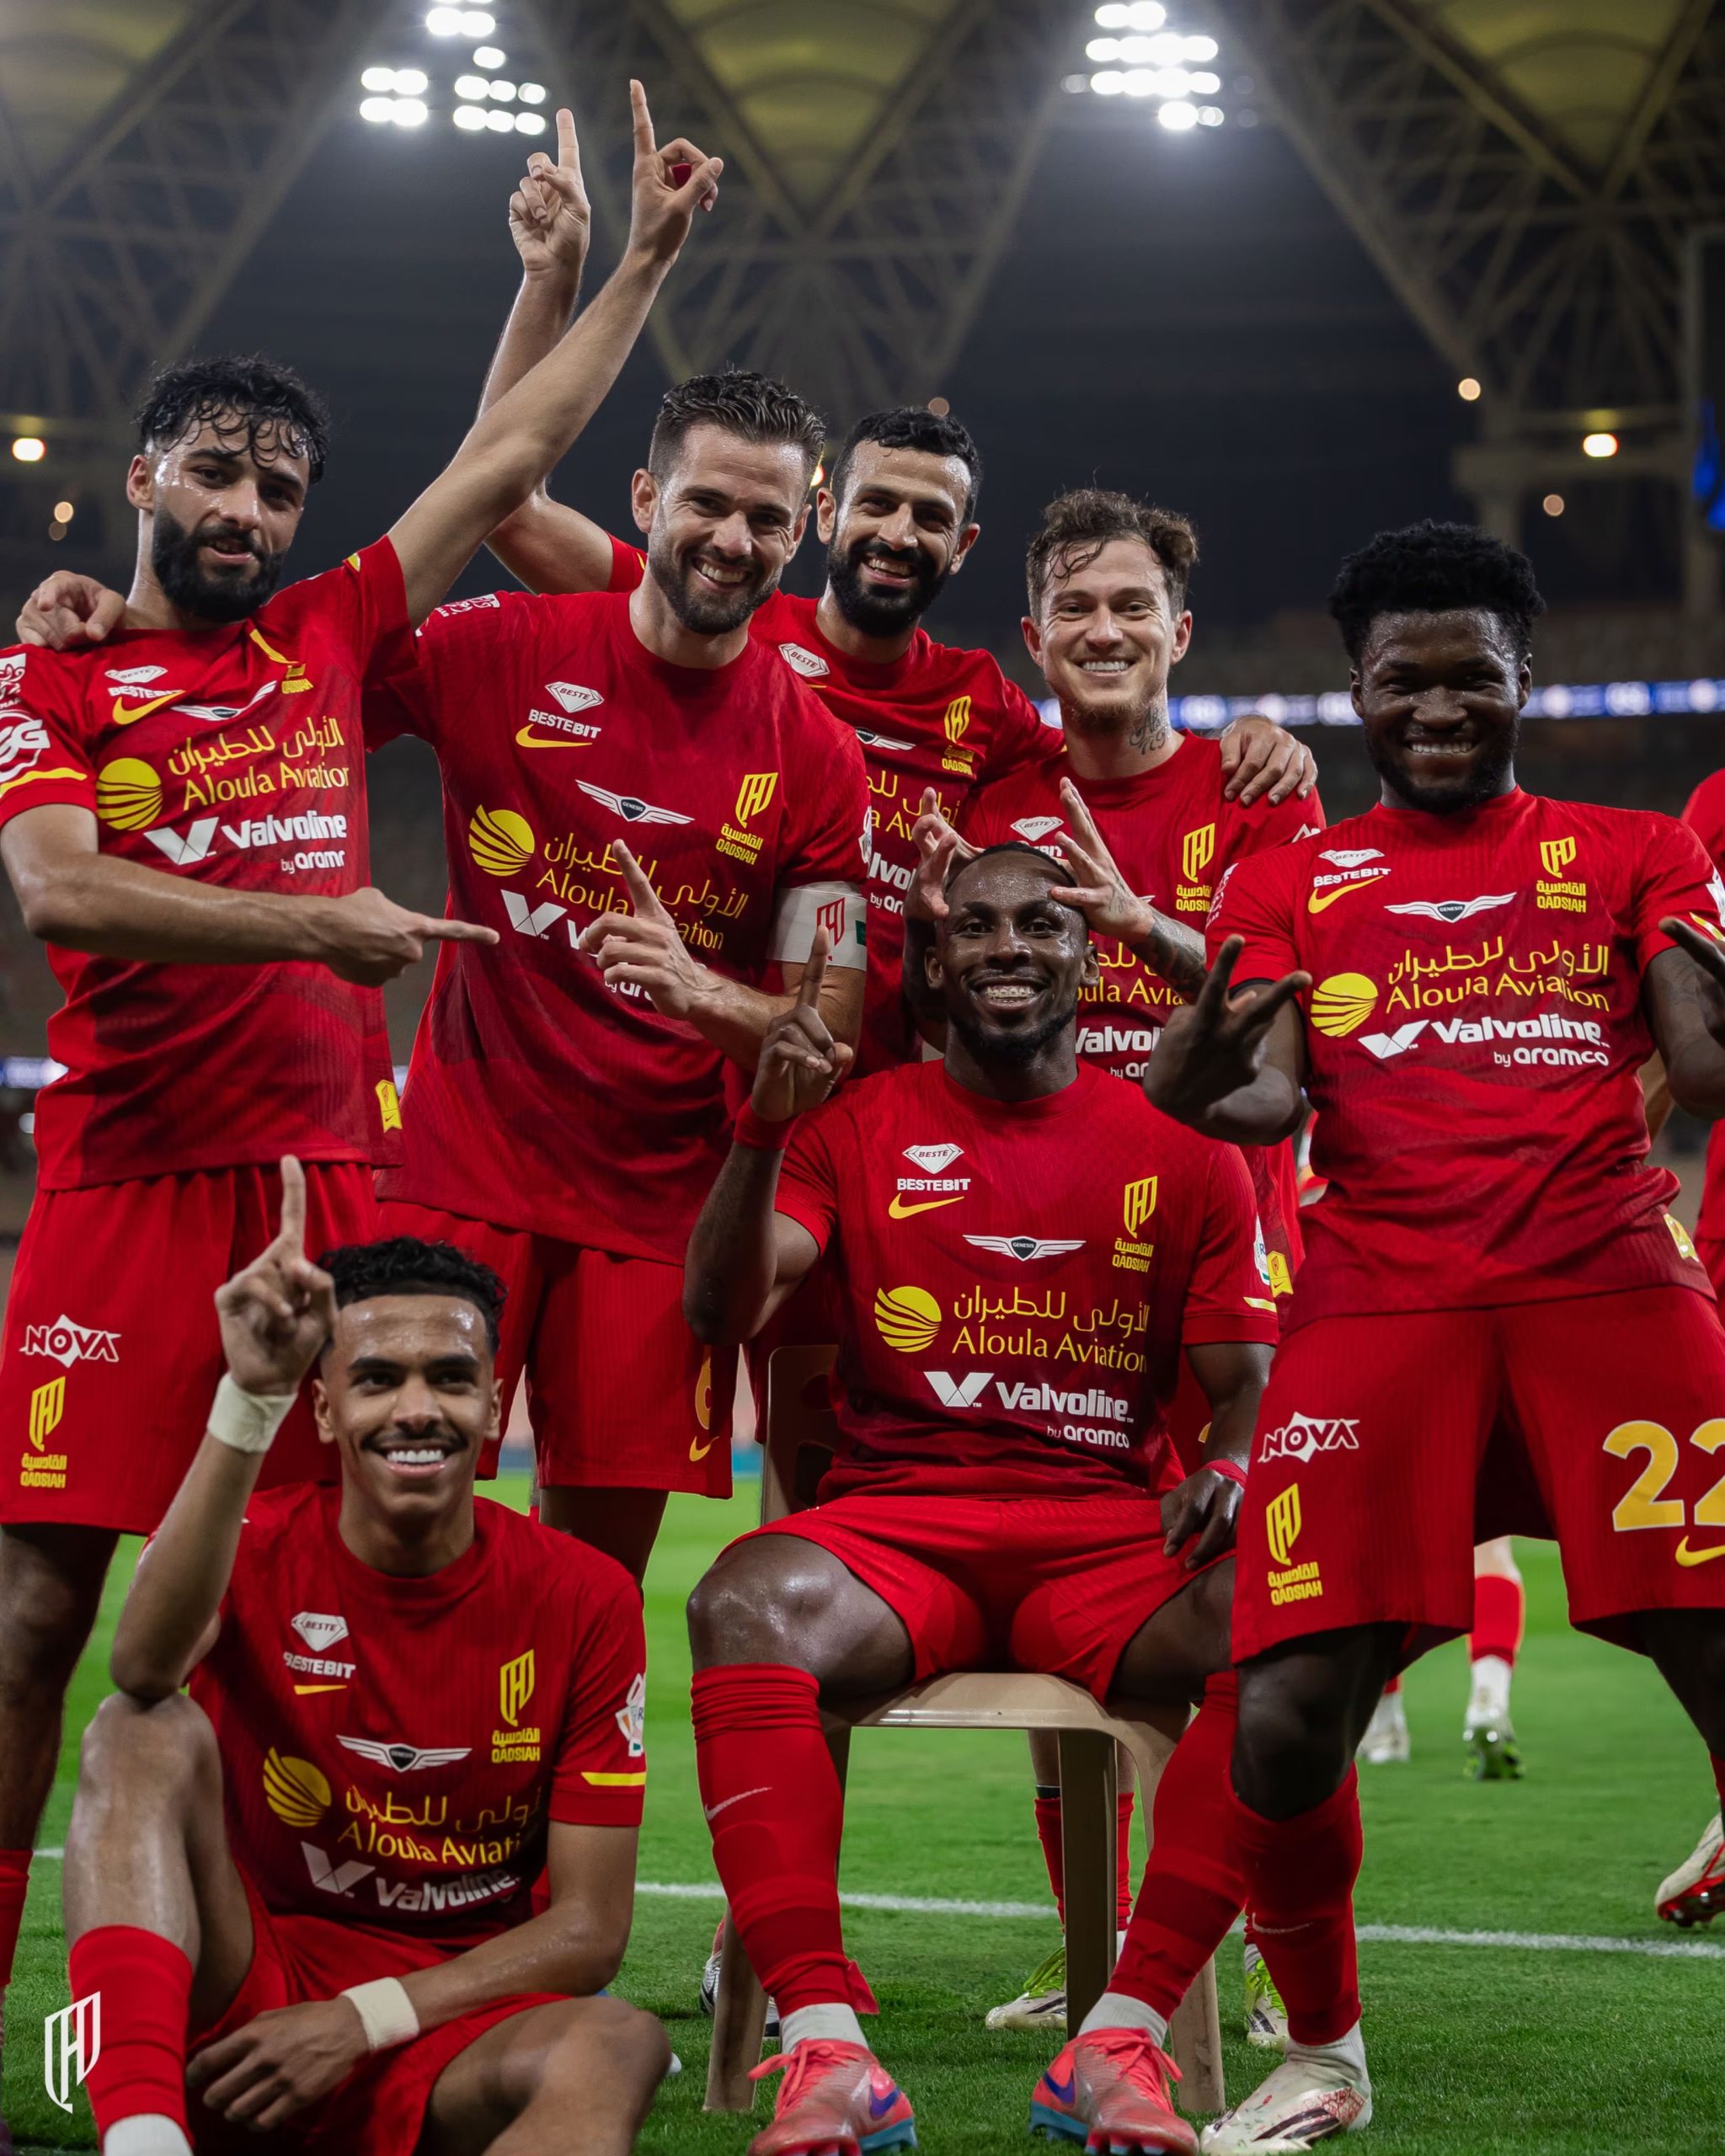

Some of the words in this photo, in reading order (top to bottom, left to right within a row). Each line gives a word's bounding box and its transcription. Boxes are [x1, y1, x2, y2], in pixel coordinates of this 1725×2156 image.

[789, 651, 819, 670] BESTE
[108, 685, 179, 699] BESTEB
[559, 687, 591, 701] BESTE
[528, 708, 602, 739] BESTEBIT
[168, 725, 276, 776] للطيران
[942, 758, 974, 776] QADS
[183, 766, 277, 811] Aloula
[221, 810, 348, 850] Valvoline
[720, 823, 764, 851] القادسية
[280, 857, 296, 875] by
[294, 850, 345, 870] aram
[543, 832, 658, 881] لطيران
[715, 839, 758, 866] QADSIAH
[1313, 867, 1391, 888] BESTEBIT
[1535, 879, 1587, 897] القادسية
[535, 867, 629, 915] Aloula
[674, 912, 724, 951] ation
[870, 893, 884, 909] by
[1438, 905, 1465, 913] GENESIS
[1535, 896, 1587, 913] QADSIAH
[1388, 936, 1504, 985] للطيران
[1509, 940, 1610, 977] الأولى
[1076, 976, 1121, 1003] ula
[1126, 978, 1184, 1006] Avia
[1386, 975, 1489, 1014] Aloula
[1075, 1026, 1165, 1054] Valvol
[1430, 1013, 1602, 1045] Valvoline
[1493, 1051, 1512, 1067] by
[1513, 1047, 1610, 1067] aramco
[918, 1149, 949, 1159] BESTE
[897, 1177, 971, 1192] BESTEBIT
[1114, 1237, 1154, 1258] القادسية
[1111, 1253, 1151, 1273] QADSIAH
[953, 1285, 1066, 1323] للطيران
[23, 1322, 120, 1364] NOVA
[951, 1326, 1048, 1358] Aloula
[995, 1381, 1129, 1422] Valvoline
[1063, 1424, 1130, 1449] aramco
[1261, 1417, 1360, 1464] NOVA
[21, 1452, 67, 1470] القادسية
[20, 1470, 67, 1489] QADSIAH
[1268, 1561, 1320, 1589] القادسية
[1270, 1580, 1323, 1606] QADSIAH
[305, 1620, 338, 1632] BESTE
[492, 1728, 540, 1748] القادسية
[491, 1746, 541, 1764] QADSIAH
[337, 1819, 439, 1863] Aloula
[441, 1832, 521, 1866] Aviati
[376, 1868, 516, 1912] Valvoline
